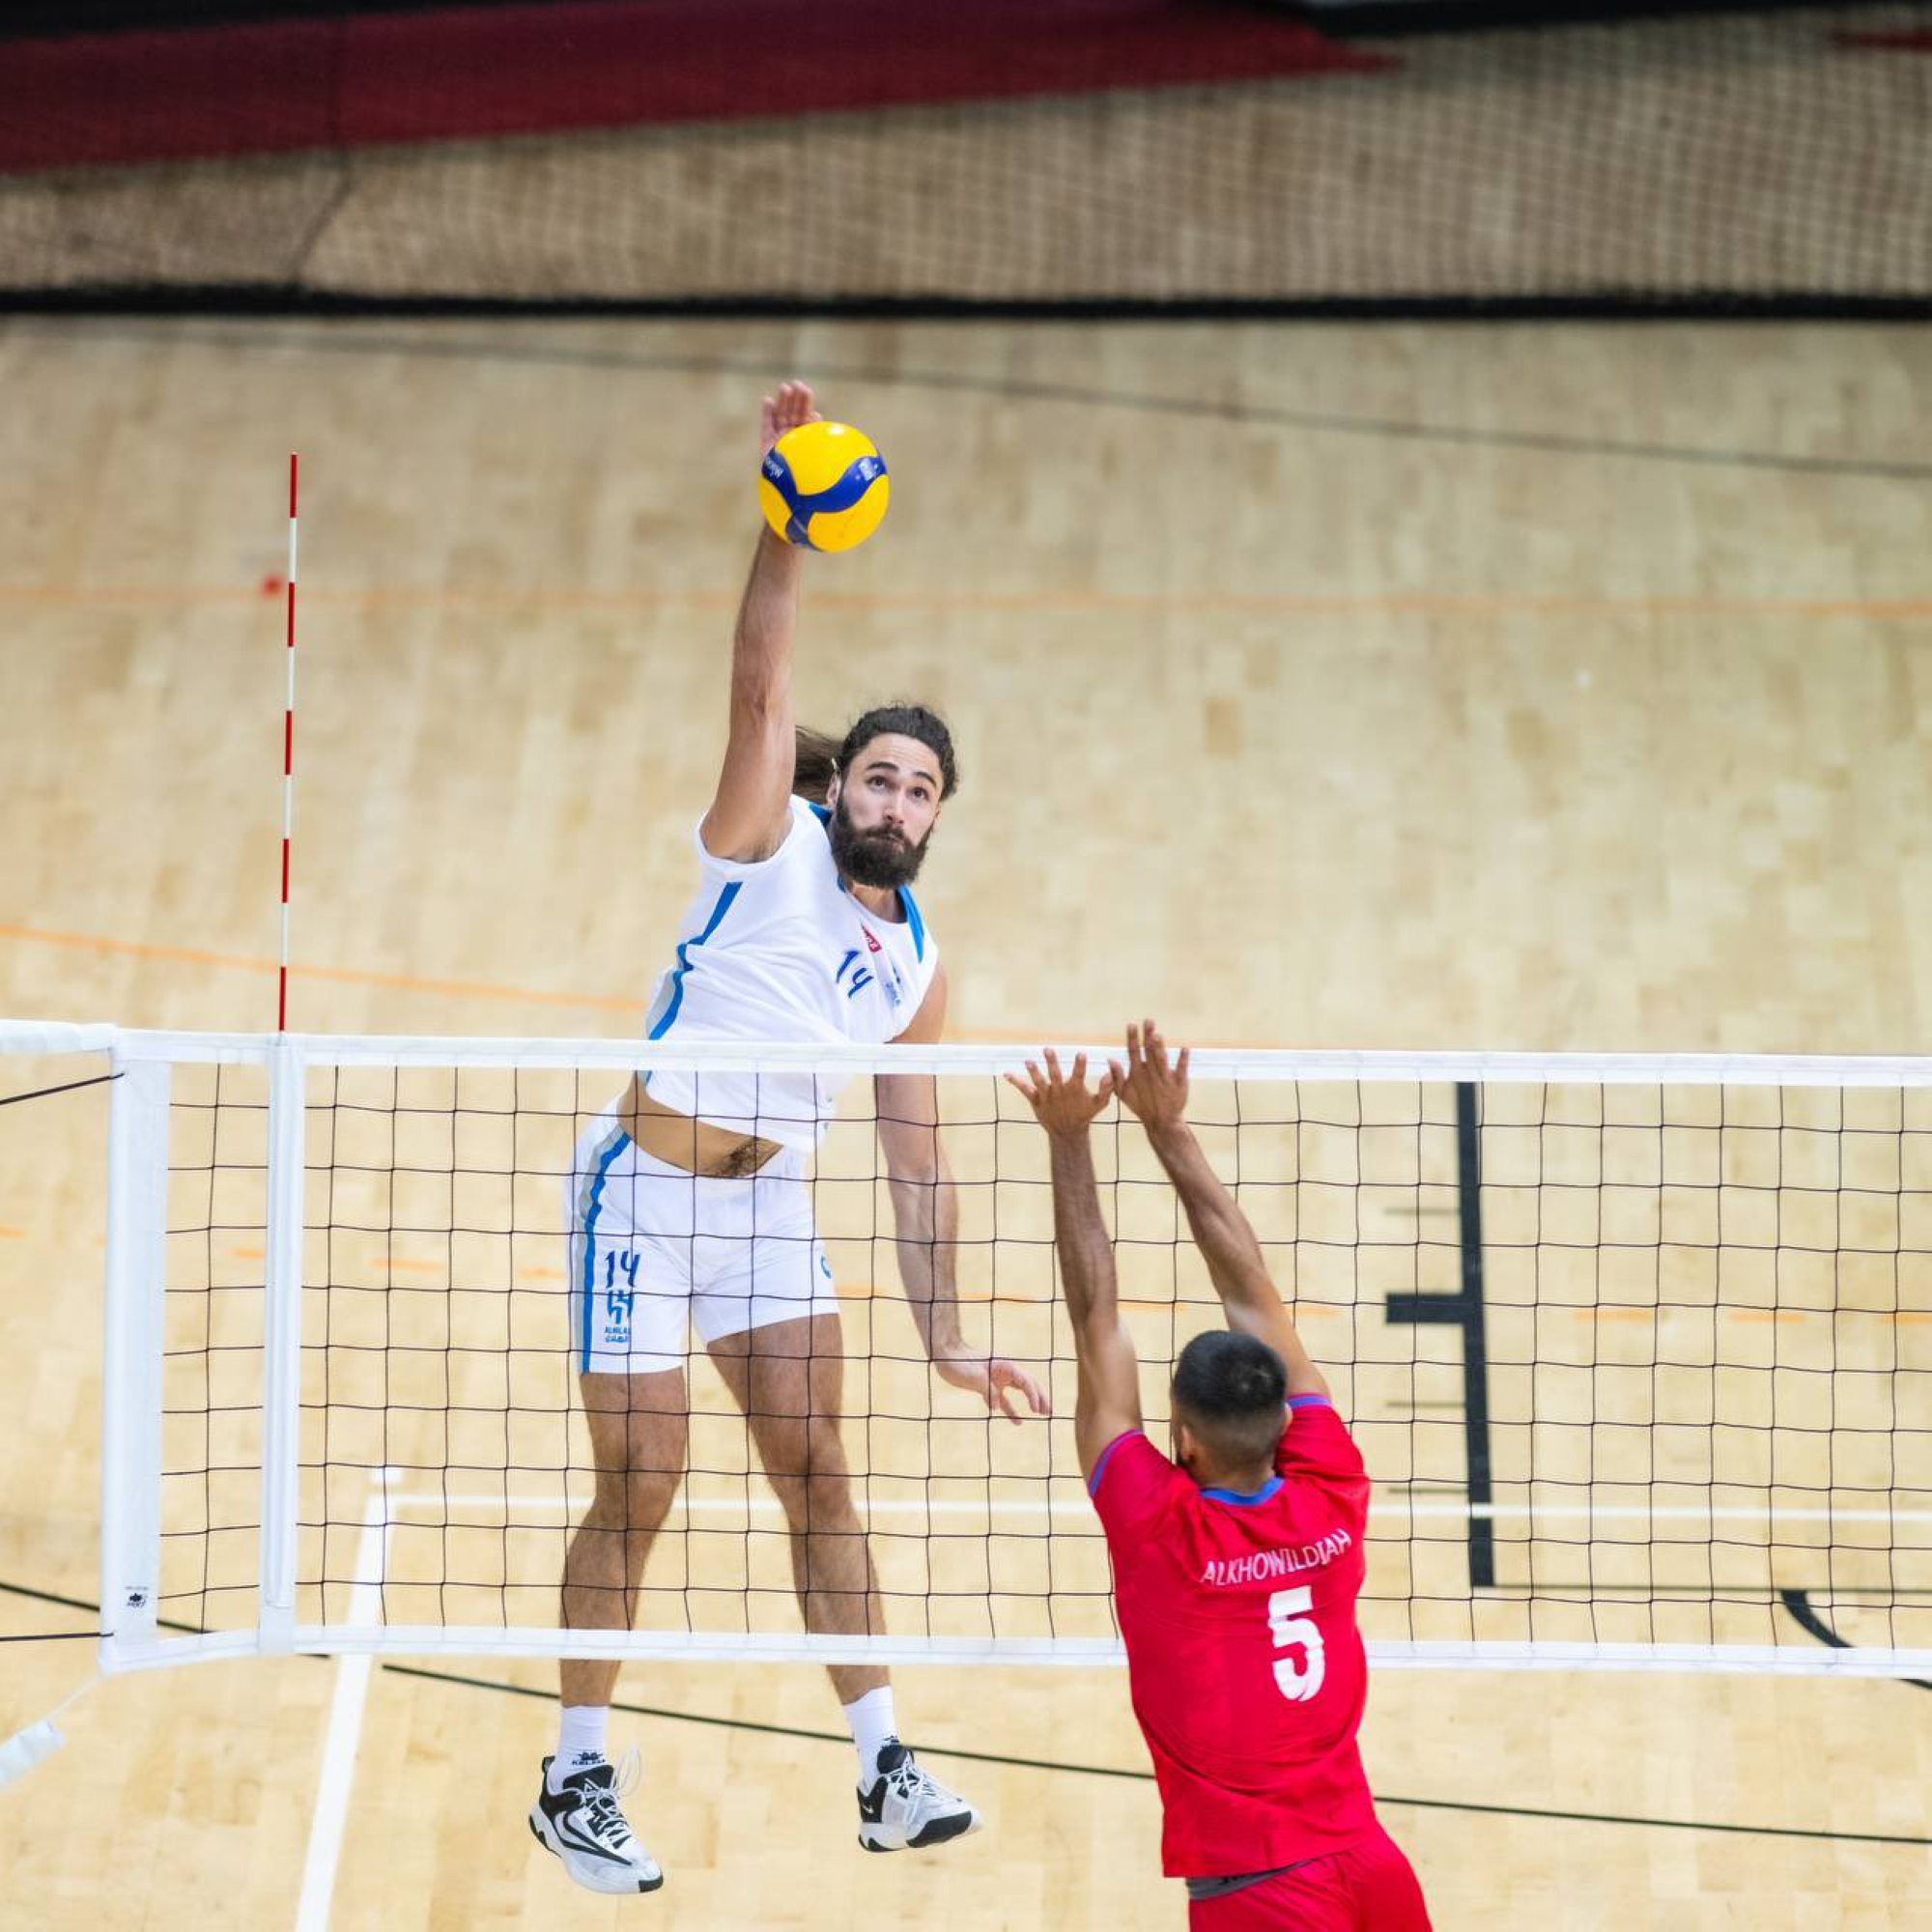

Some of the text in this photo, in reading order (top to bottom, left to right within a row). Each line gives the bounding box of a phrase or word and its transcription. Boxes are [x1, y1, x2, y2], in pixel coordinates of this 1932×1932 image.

[836, 950, 873, 998] 14
[605, 1250, 640, 1288] 14
[1200, 1528, 1351, 1586] ALKHOWILDIAH
[1268, 1584, 1325, 1702] 5
